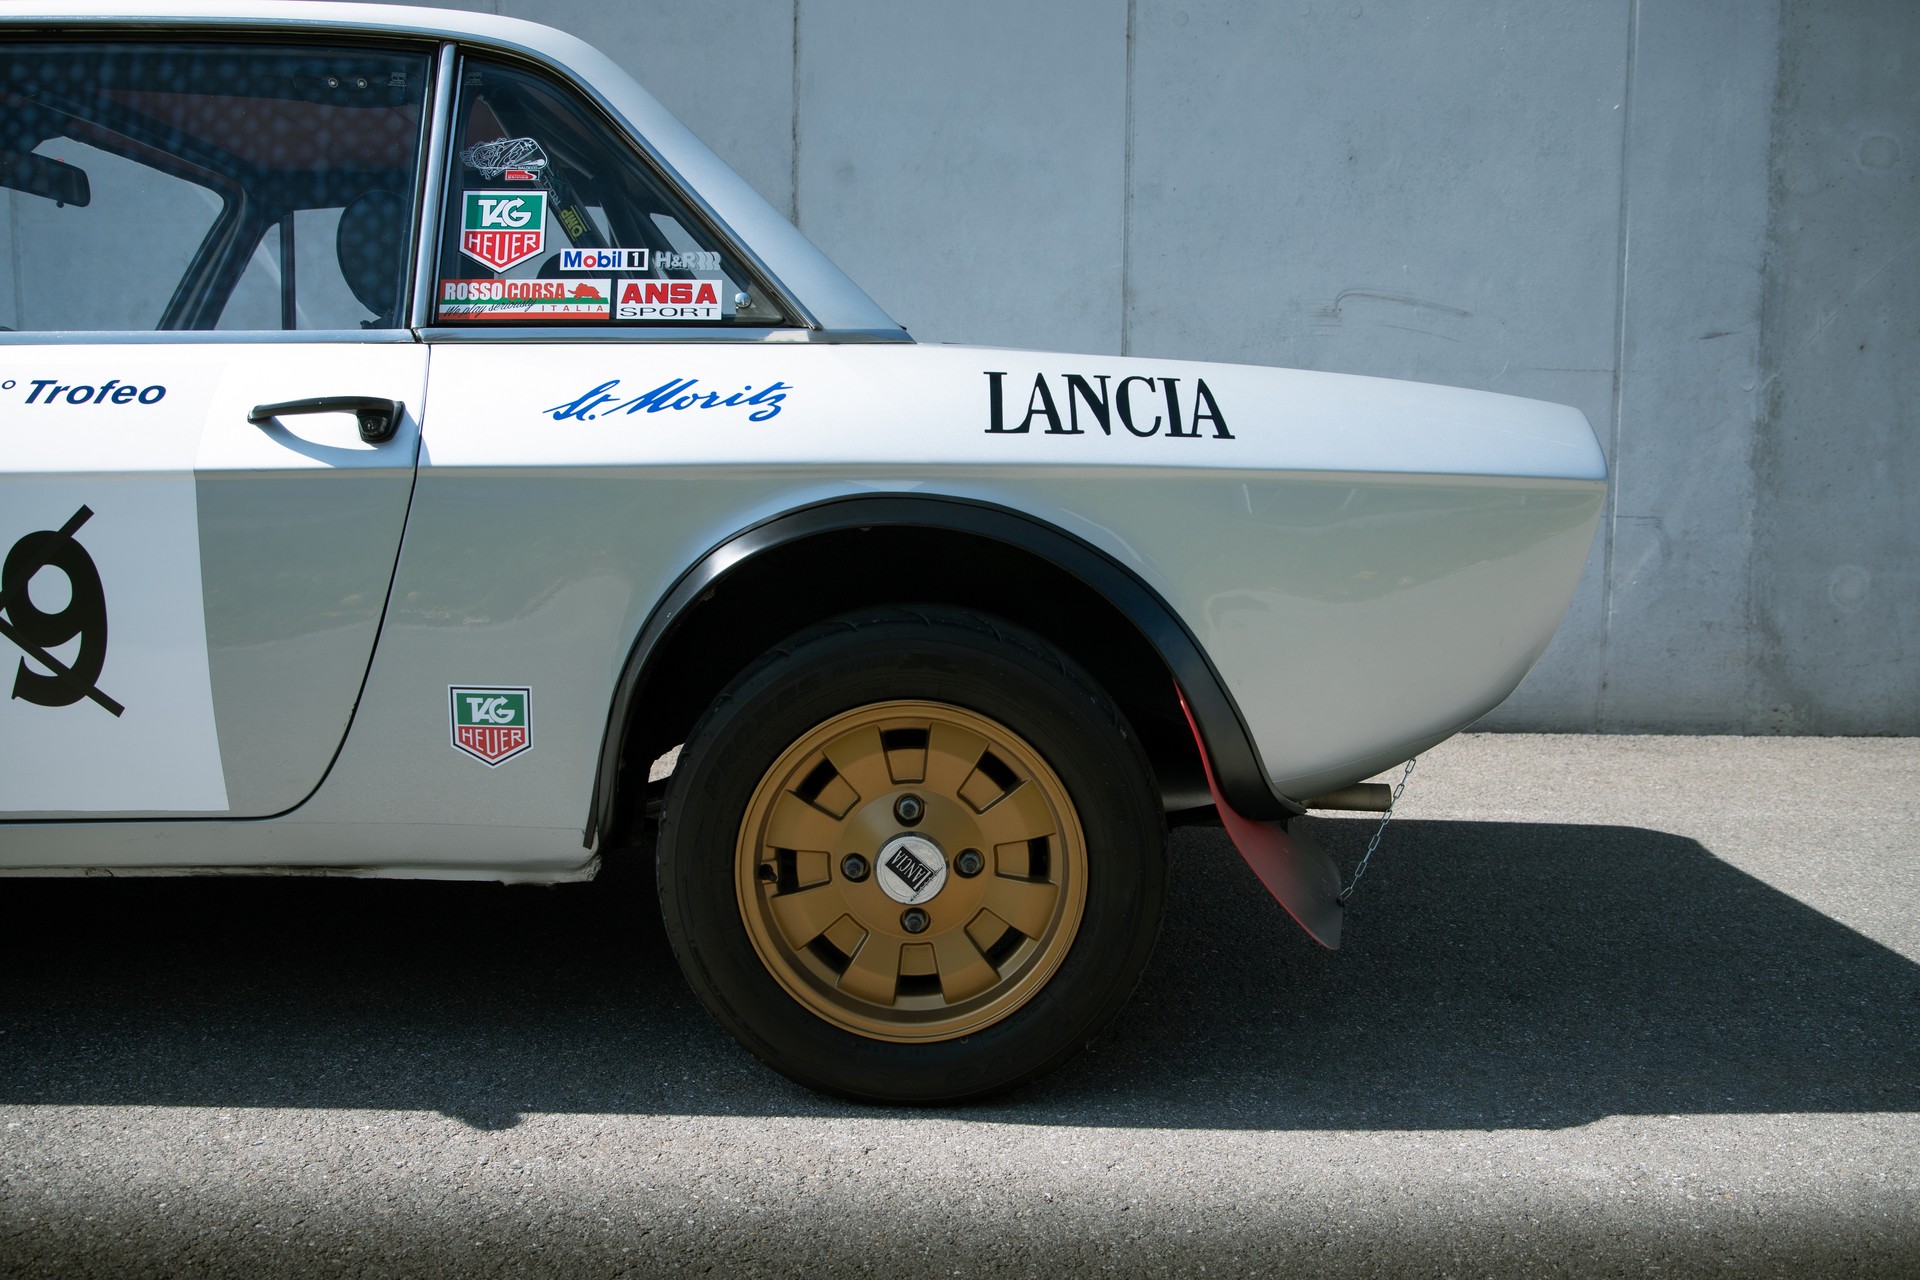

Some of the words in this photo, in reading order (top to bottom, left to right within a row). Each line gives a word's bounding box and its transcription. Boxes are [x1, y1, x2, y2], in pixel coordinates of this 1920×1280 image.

[478, 196, 532, 227] TAG
[561, 209, 583, 238] OMP
[468, 233, 536, 264] HEUER
[564, 250, 622, 268] Mobil
[444, 282, 502, 301] ROSSO
[503, 282, 565, 301] CORSA
[620, 283, 718, 304] ANSA
[459, 303, 486, 319] play
[488, 298, 538, 313] seriously
[541, 304, 604, 312] ITALIA
[620, 307, 718, 317] SPORT
[25, 379, 167, 405] Trofeo
[542, 379, 620, 421] St.
[601, 378, 793, 422] Moritz
[983, 371, 1236, 439] LANCIA
[466, 695, 516, 724] TAG
[461, 728, 523, 757] HEUER
[891, 849, 933, 891] LANCIA
